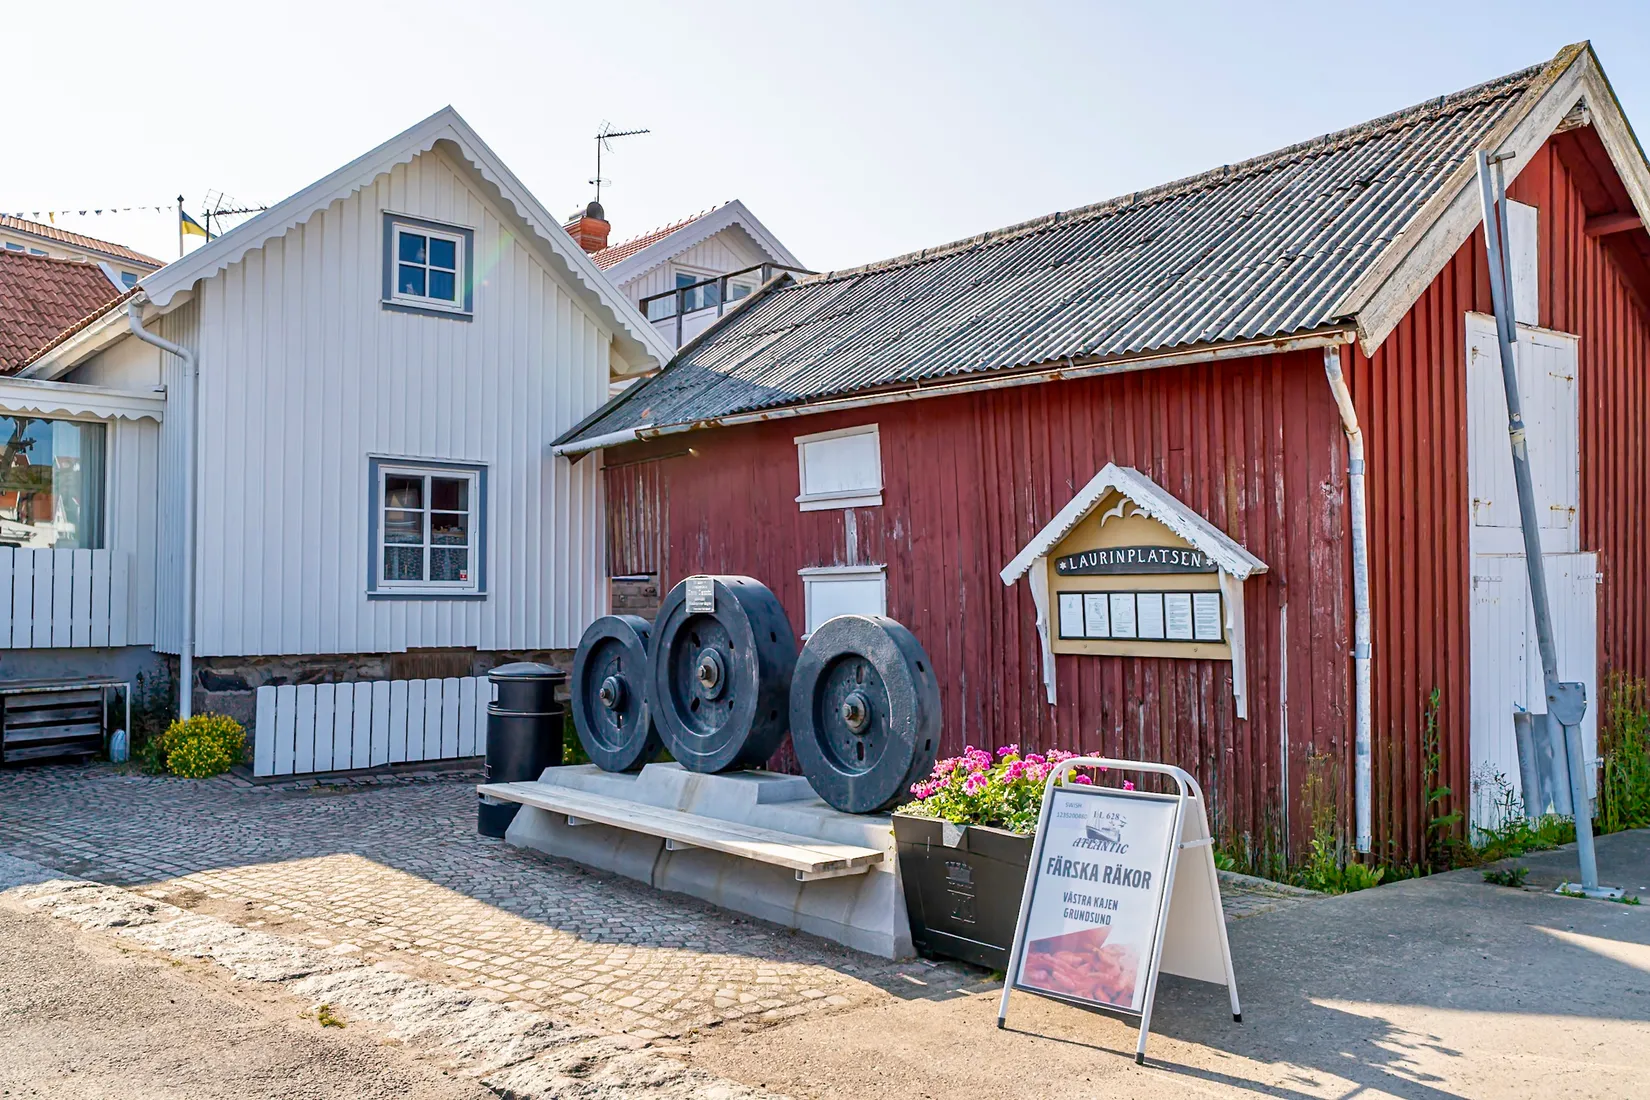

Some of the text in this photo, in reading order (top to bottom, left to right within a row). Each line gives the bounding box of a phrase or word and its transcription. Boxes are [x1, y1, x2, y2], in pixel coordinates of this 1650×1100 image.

[1069, 549, 1201, 570] LAURINPLATSEN
[1106, 812, 1120, 820] 628
[1072, 837, 1129, 854] ATLANTIC
[1046, 855, 1152, 890] FÄRSKA RÄKOR
[1063, 891, 1119, 911] VÄSTRA KAJEN
[1063, 907, 1112, 925] GRUNDSUND
